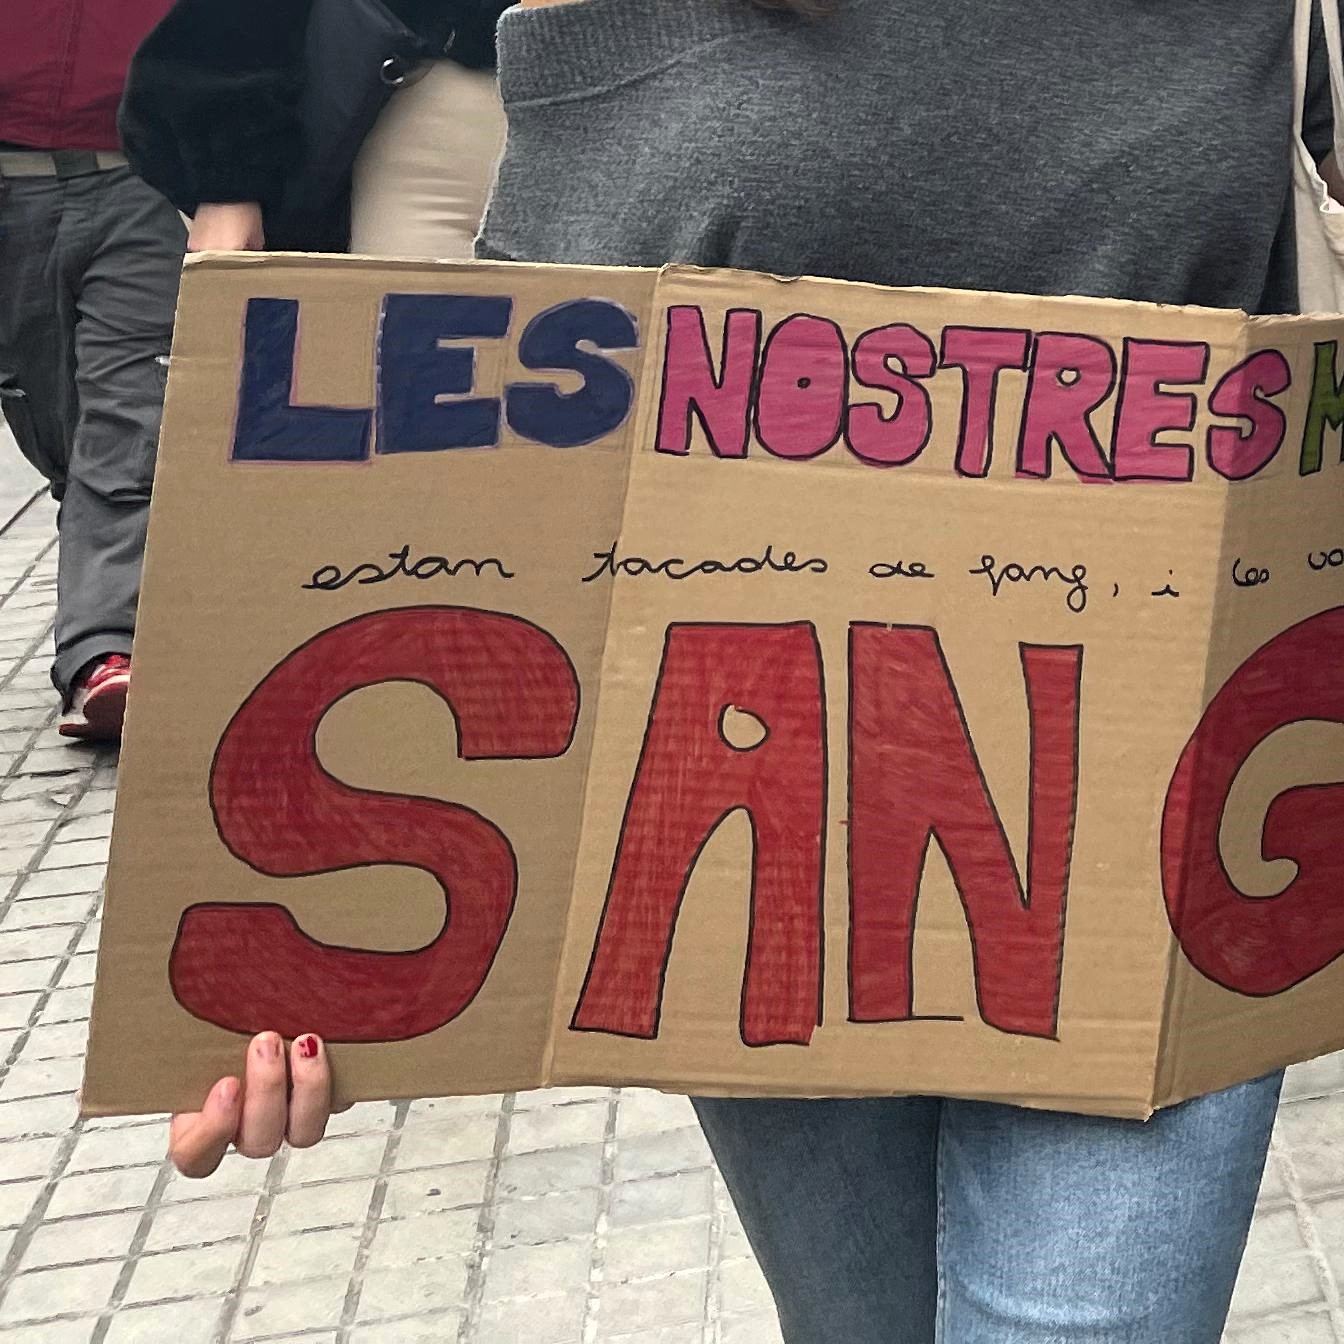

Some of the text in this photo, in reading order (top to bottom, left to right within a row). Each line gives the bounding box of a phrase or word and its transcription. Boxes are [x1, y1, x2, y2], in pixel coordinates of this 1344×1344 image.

[230, 293, 640, 463] LES
[655, 305, 1292, 484] NOSTRES
[301, 544, 515, 591] estan
[581, 540, 829, 583] tacades
[868, 559, 935, 578] de
[1151, 569, 1180, 598] i
